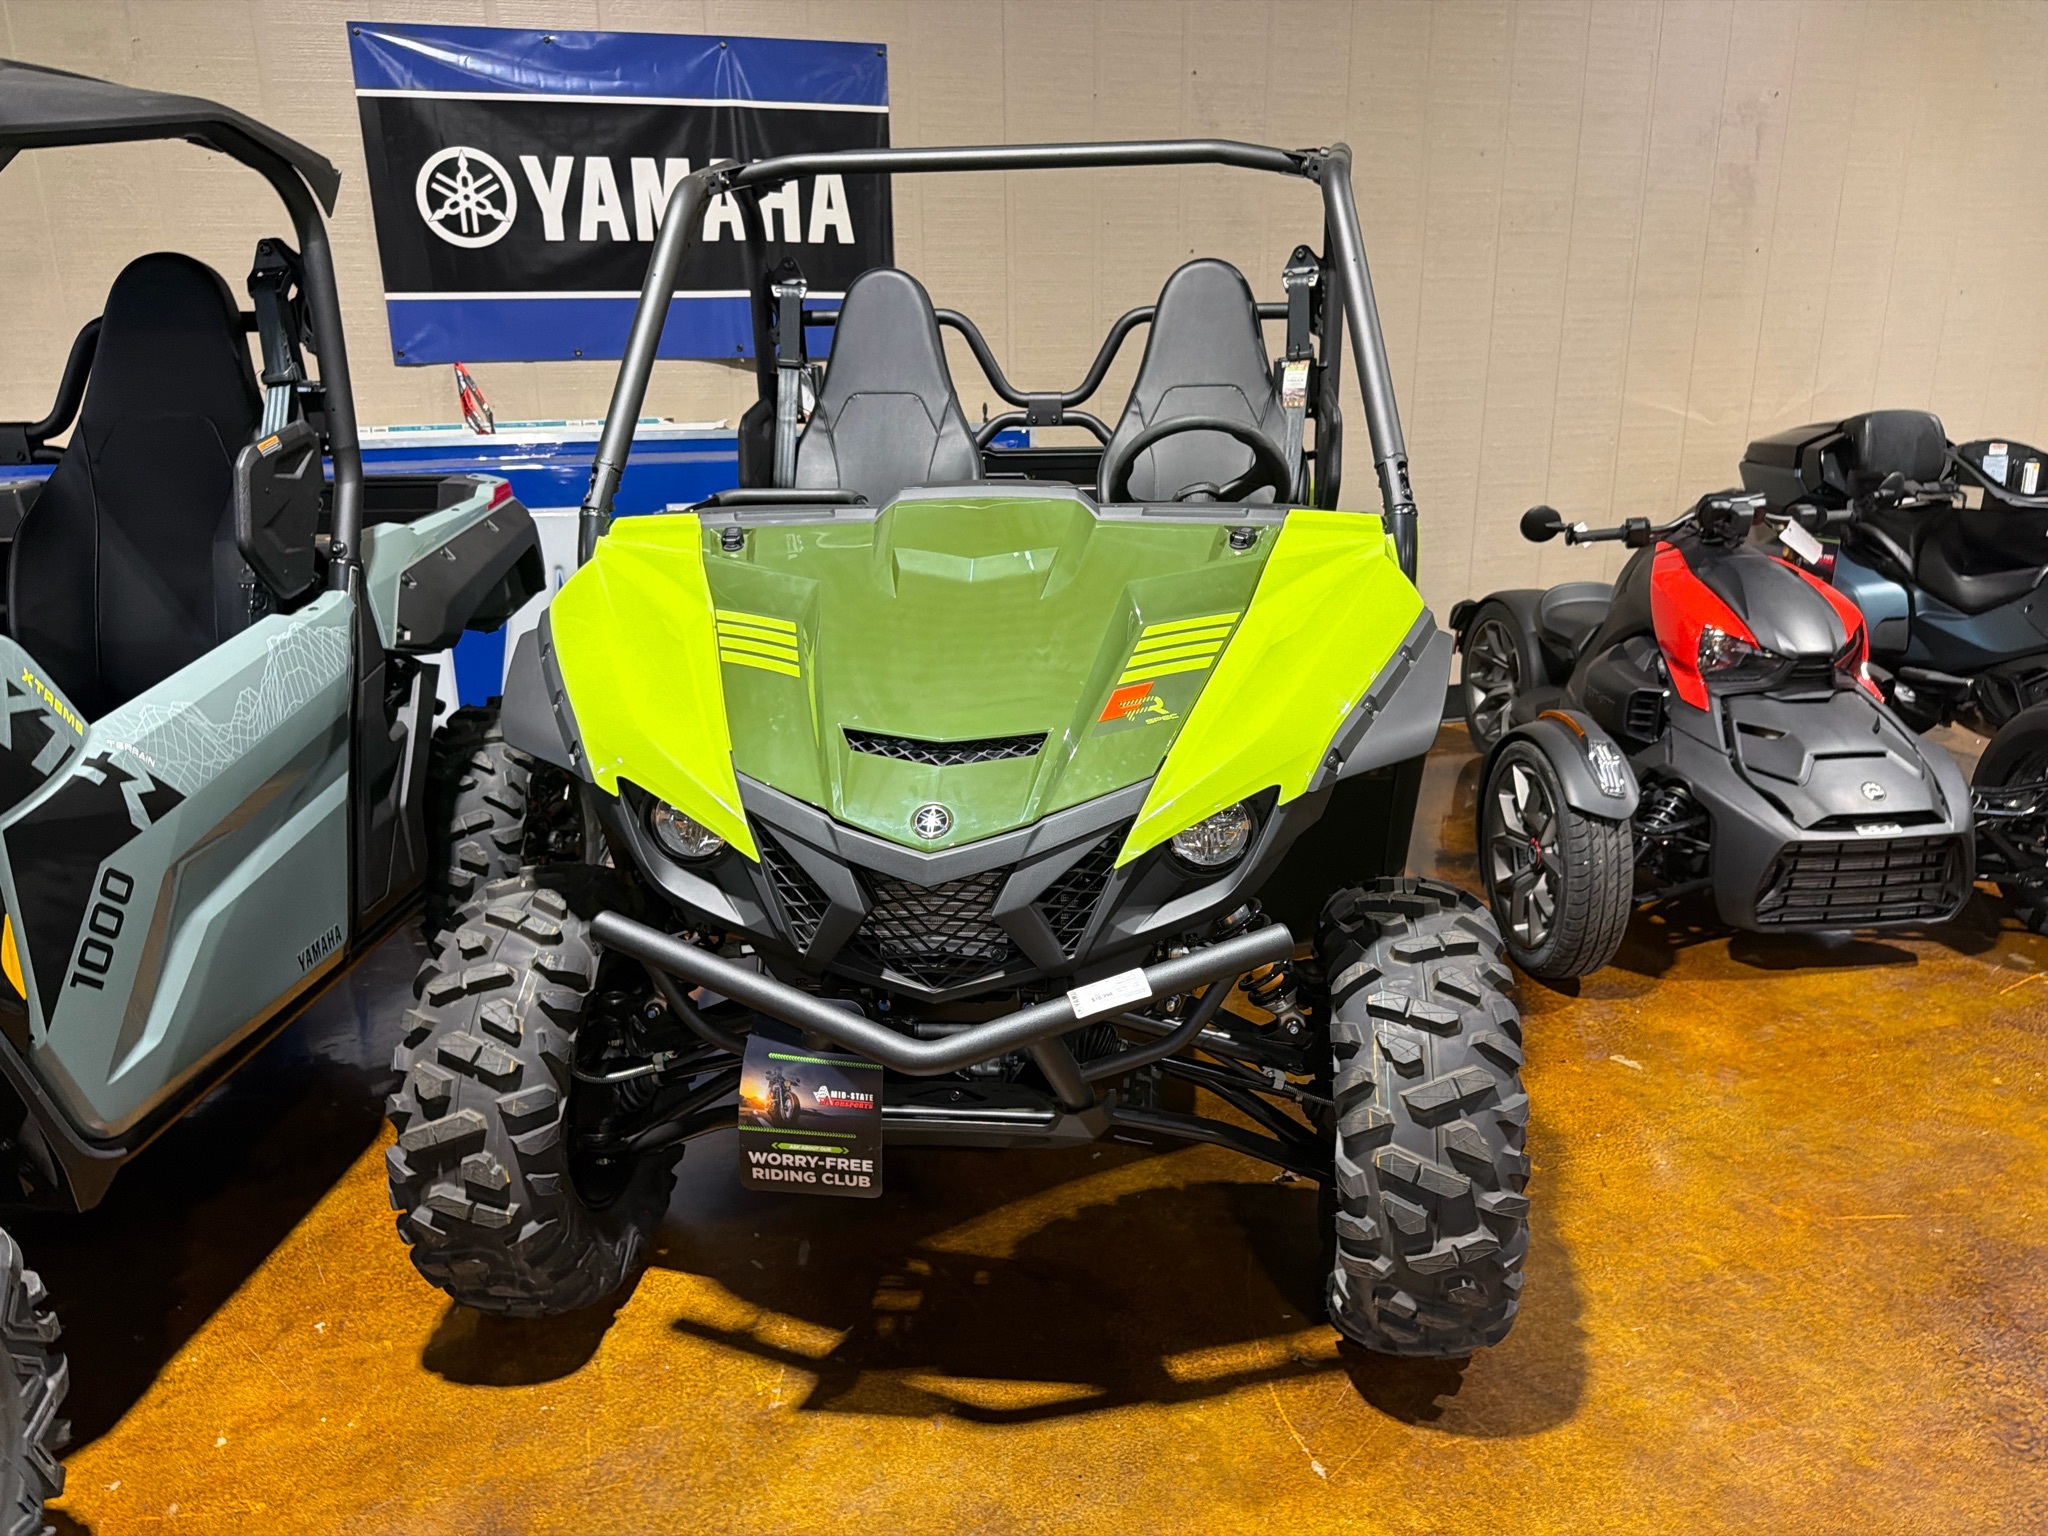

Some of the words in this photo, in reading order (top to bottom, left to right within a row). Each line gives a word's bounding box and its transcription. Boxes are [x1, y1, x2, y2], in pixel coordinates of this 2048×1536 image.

[519, 155, 855, 244] YAMAHA
[22, 667, 84, 737] XTREME
[106, 739, 156, 768] TERRAIN
[70, 867, 134, 991] 1000
[297, 924, 343, 973] YAMAHA
[830, 1090, 874, 1101] MID-STATE
[748, 1151, 874, 1173] WORRY-FREE
[752, 1167, 817, 1184] RIDING
[821, 1173, 871, 1188] CLUB
